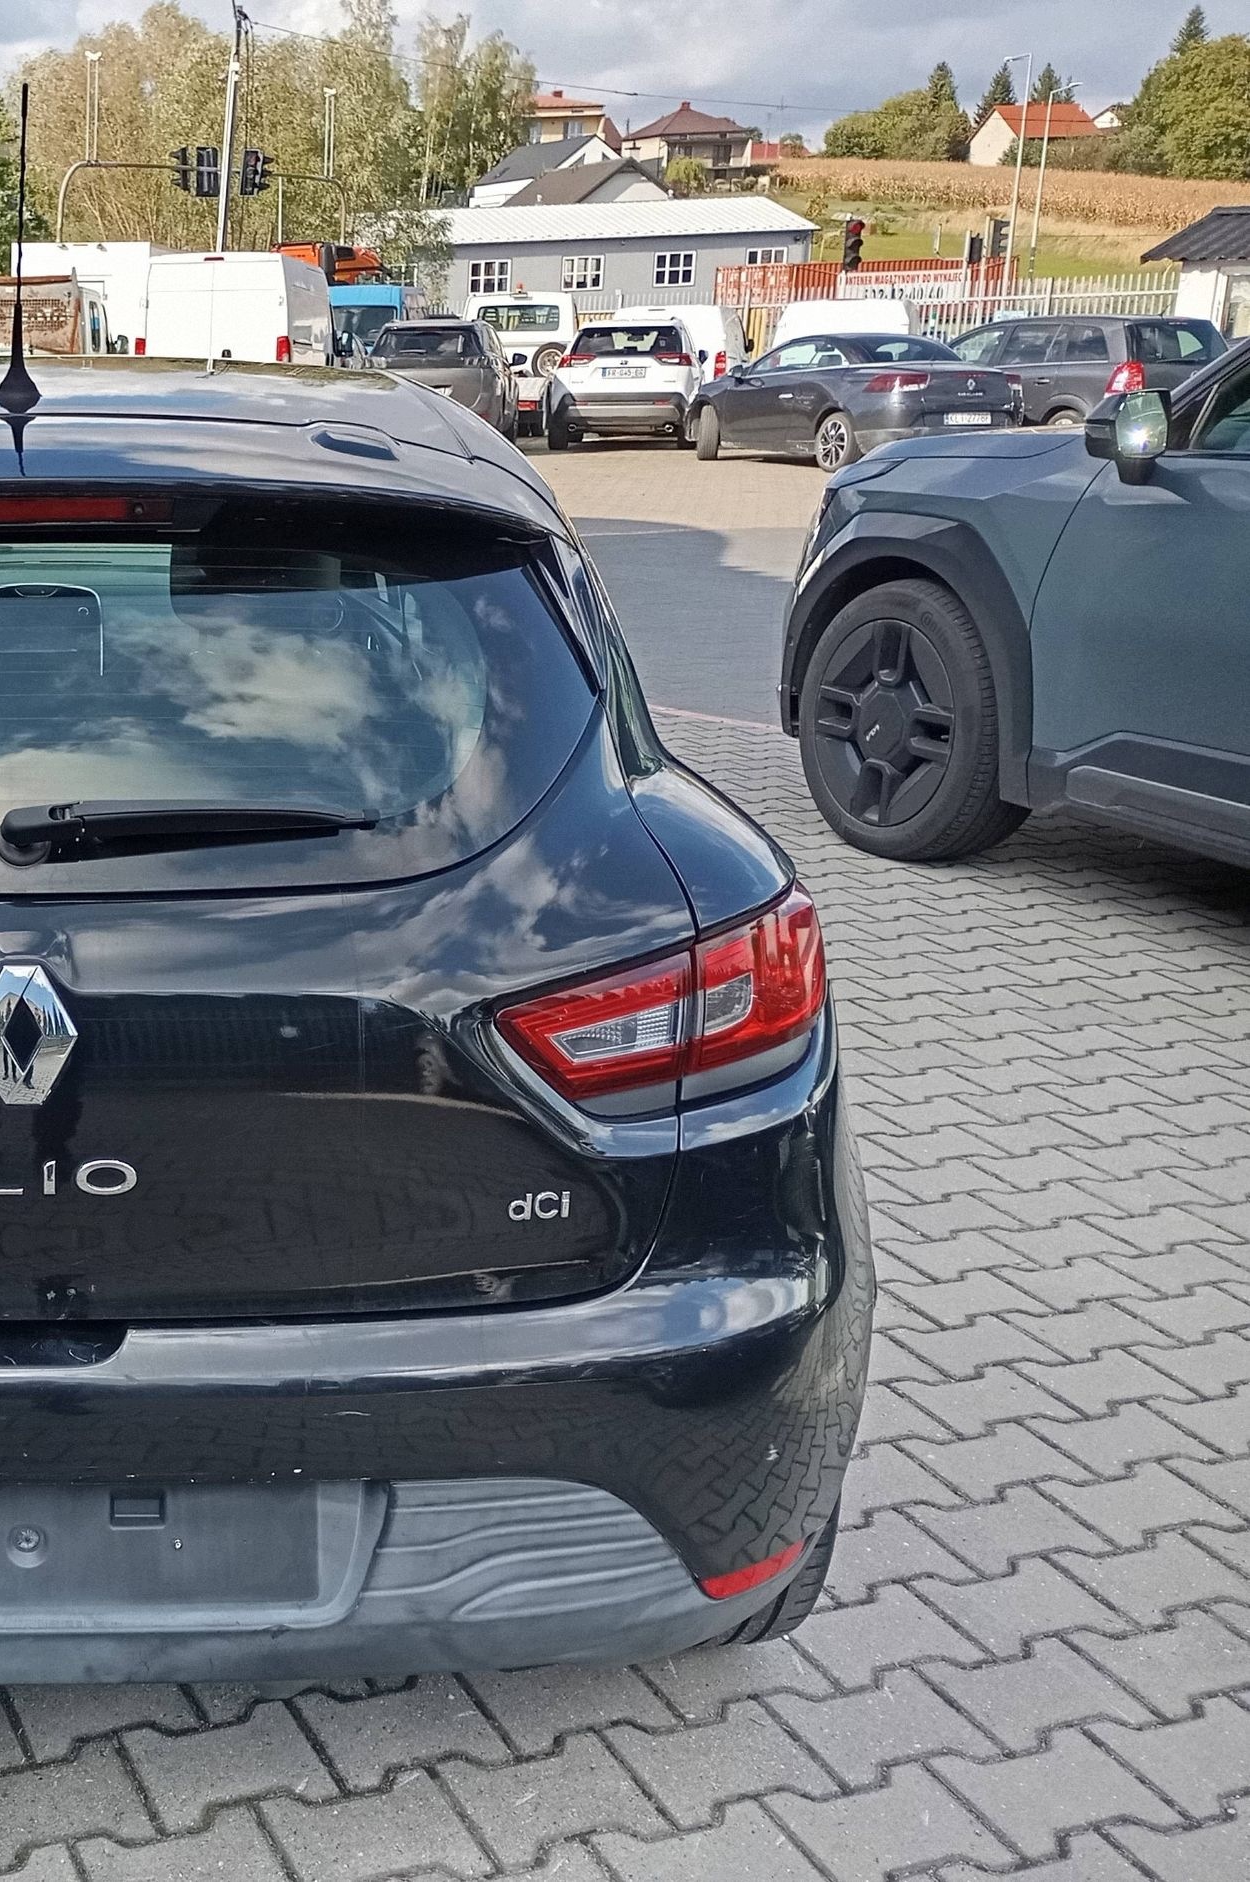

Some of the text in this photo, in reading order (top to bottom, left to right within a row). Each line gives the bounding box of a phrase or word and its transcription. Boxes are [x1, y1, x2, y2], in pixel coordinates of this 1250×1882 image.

[874, 273, 920, 285] MAGAZYNOWY
[922, 273, 932, 283] DO
[508, 1190, 571, 1221] dCi
